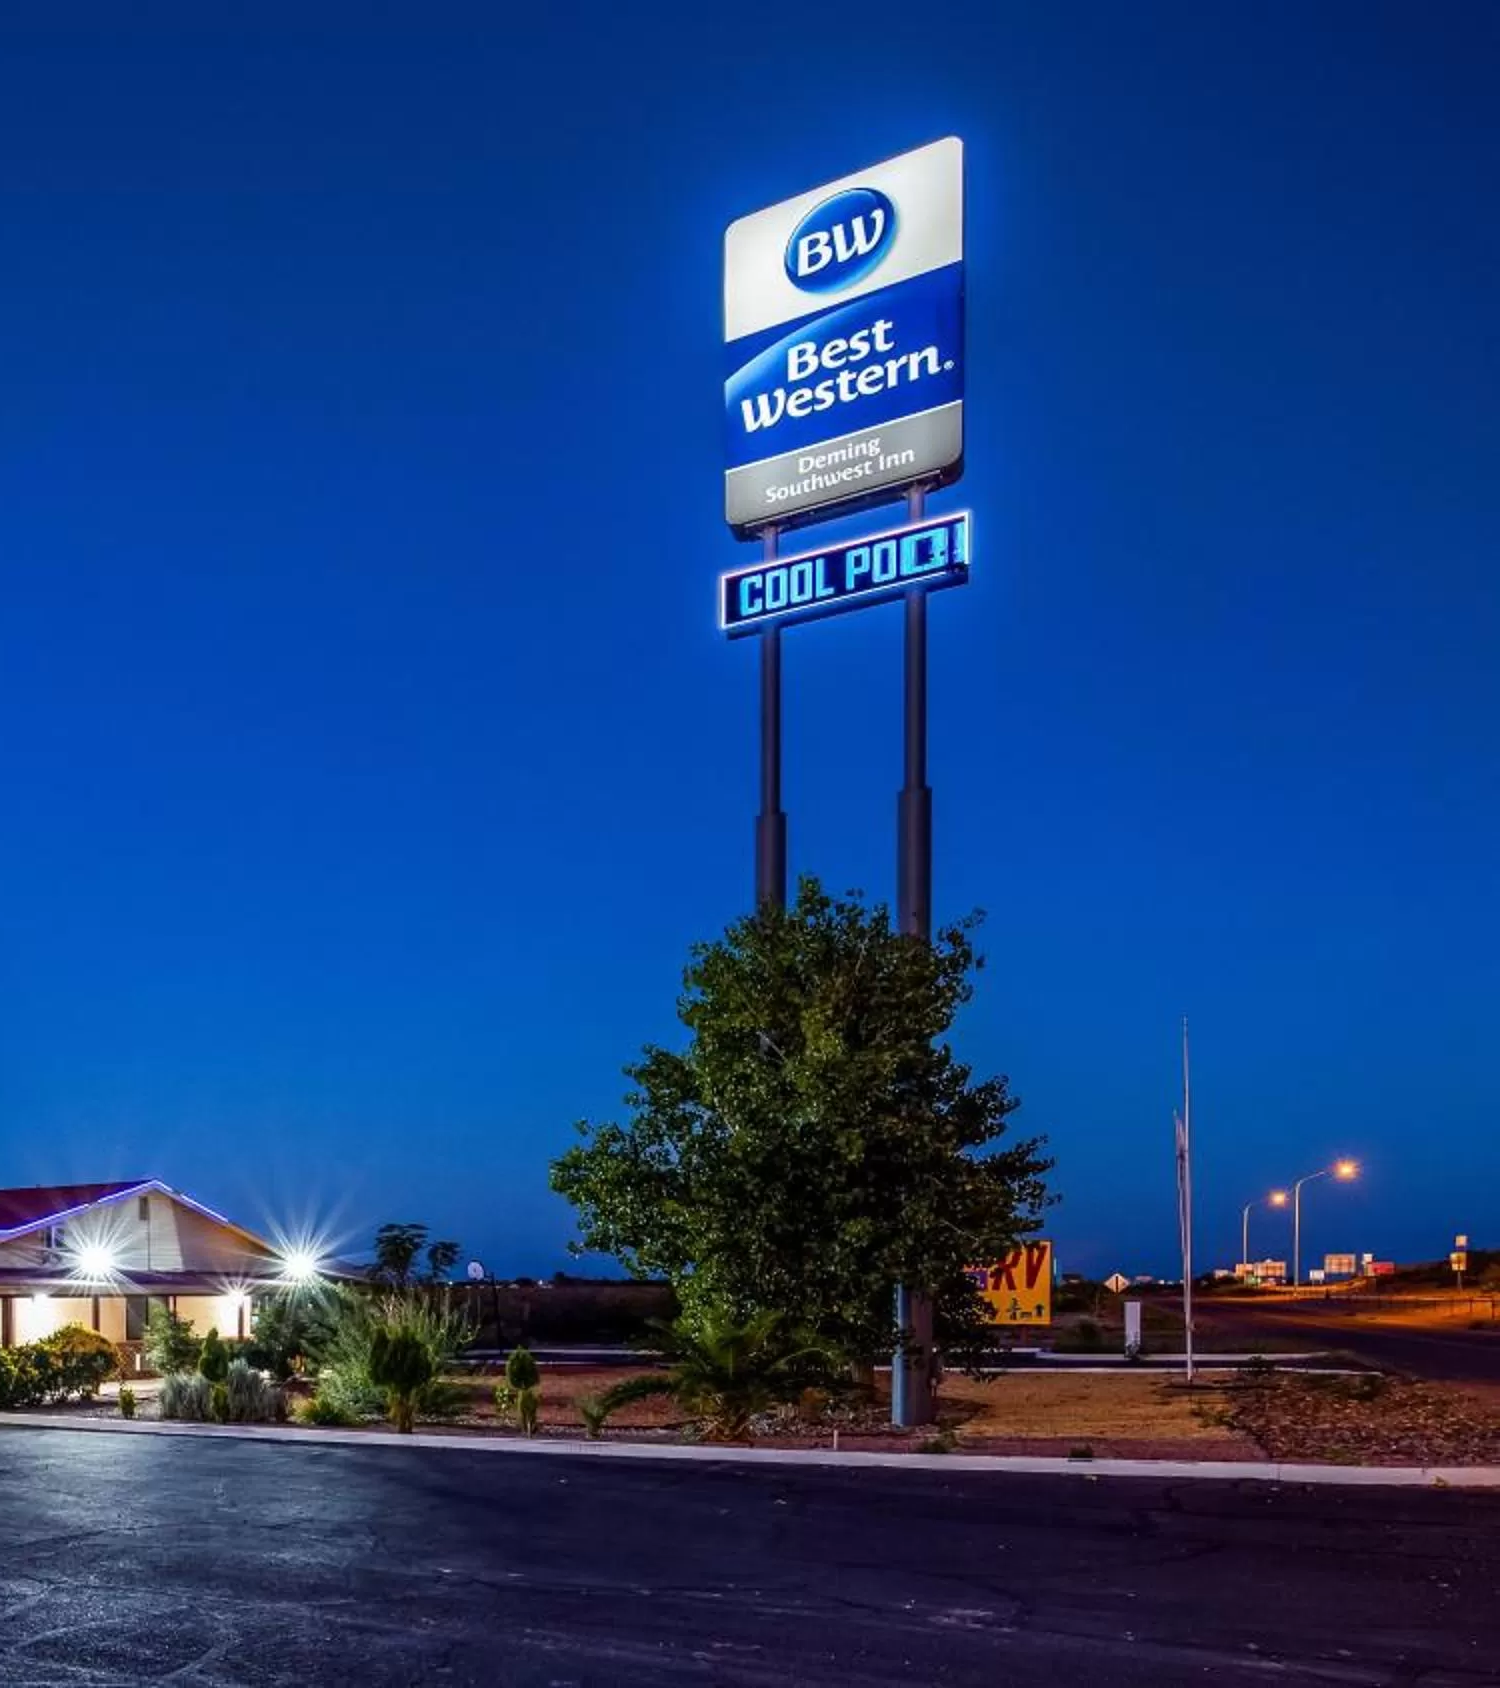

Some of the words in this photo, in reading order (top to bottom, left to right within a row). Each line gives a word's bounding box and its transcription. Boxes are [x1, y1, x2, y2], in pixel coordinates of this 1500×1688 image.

[797, 208, 885, 277] BW
[787, 319, 895, 382] Best
[764, 459, 873, 503] Southwest
[878, 448, 916, 472] Inn
[797, 437, 881, 474] Deming
[739, 556, 835, 617] COOL
[990, 1244, 1049, 1291] RV
